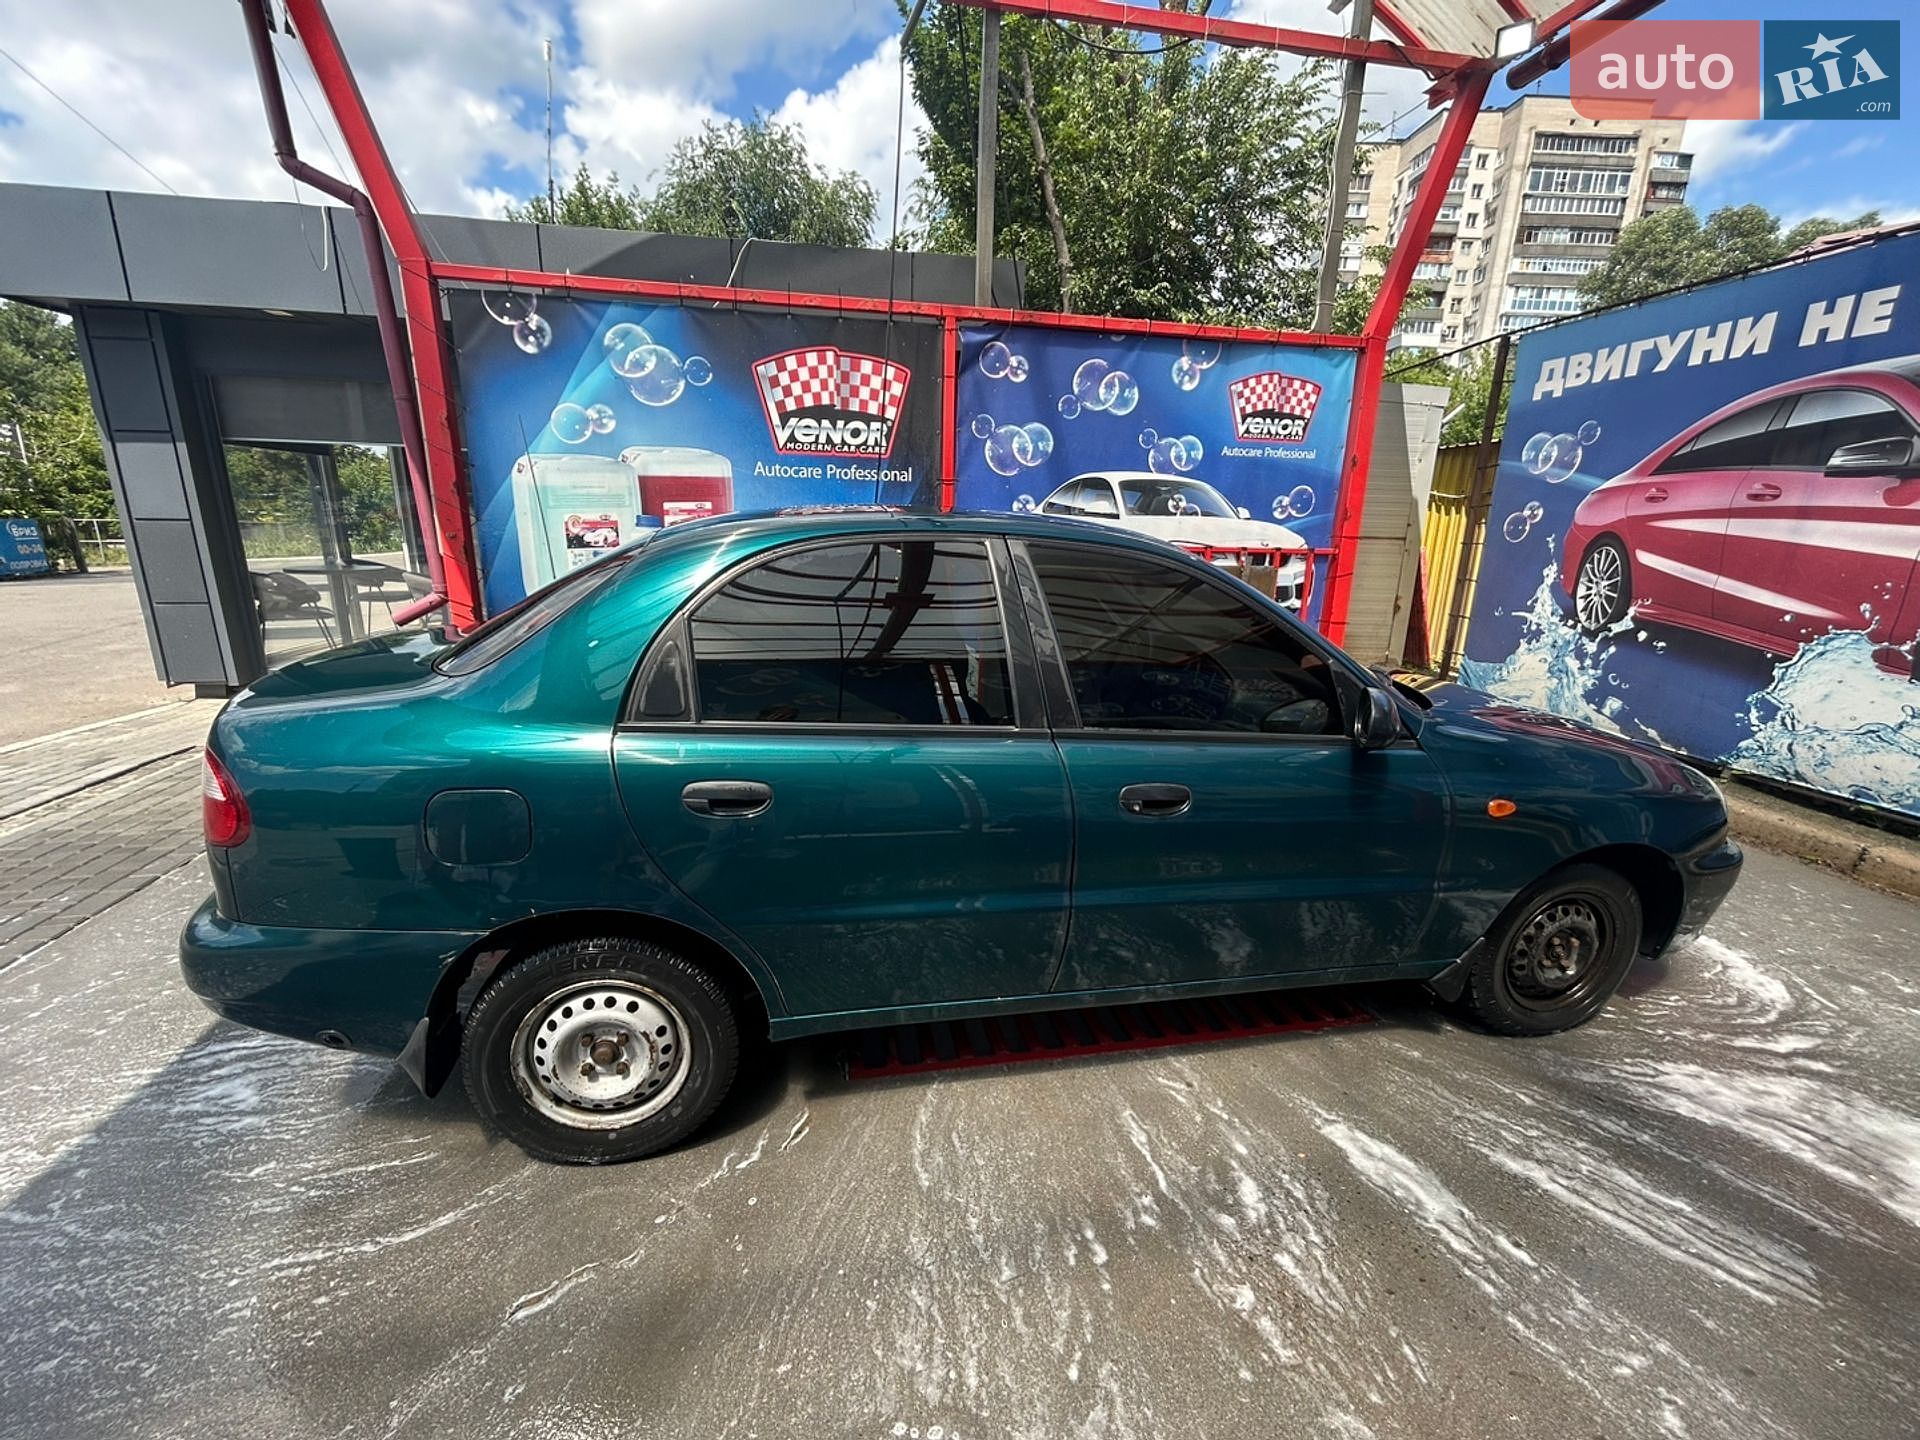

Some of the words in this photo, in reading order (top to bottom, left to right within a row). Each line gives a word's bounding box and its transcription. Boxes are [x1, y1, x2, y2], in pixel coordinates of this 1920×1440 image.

[1532, 312, 1779, 401] ДВИГУНИ
[1798, 285, 1902, 347] НЕ
[786, 441, 831, 452] MODERN
[834, 444, 856, 453] CAR
[1221, 446, 1262, 458] Autocare
[1264, 447, 1316, 460] Professional
[754, 461, 822, 479] Autocare
